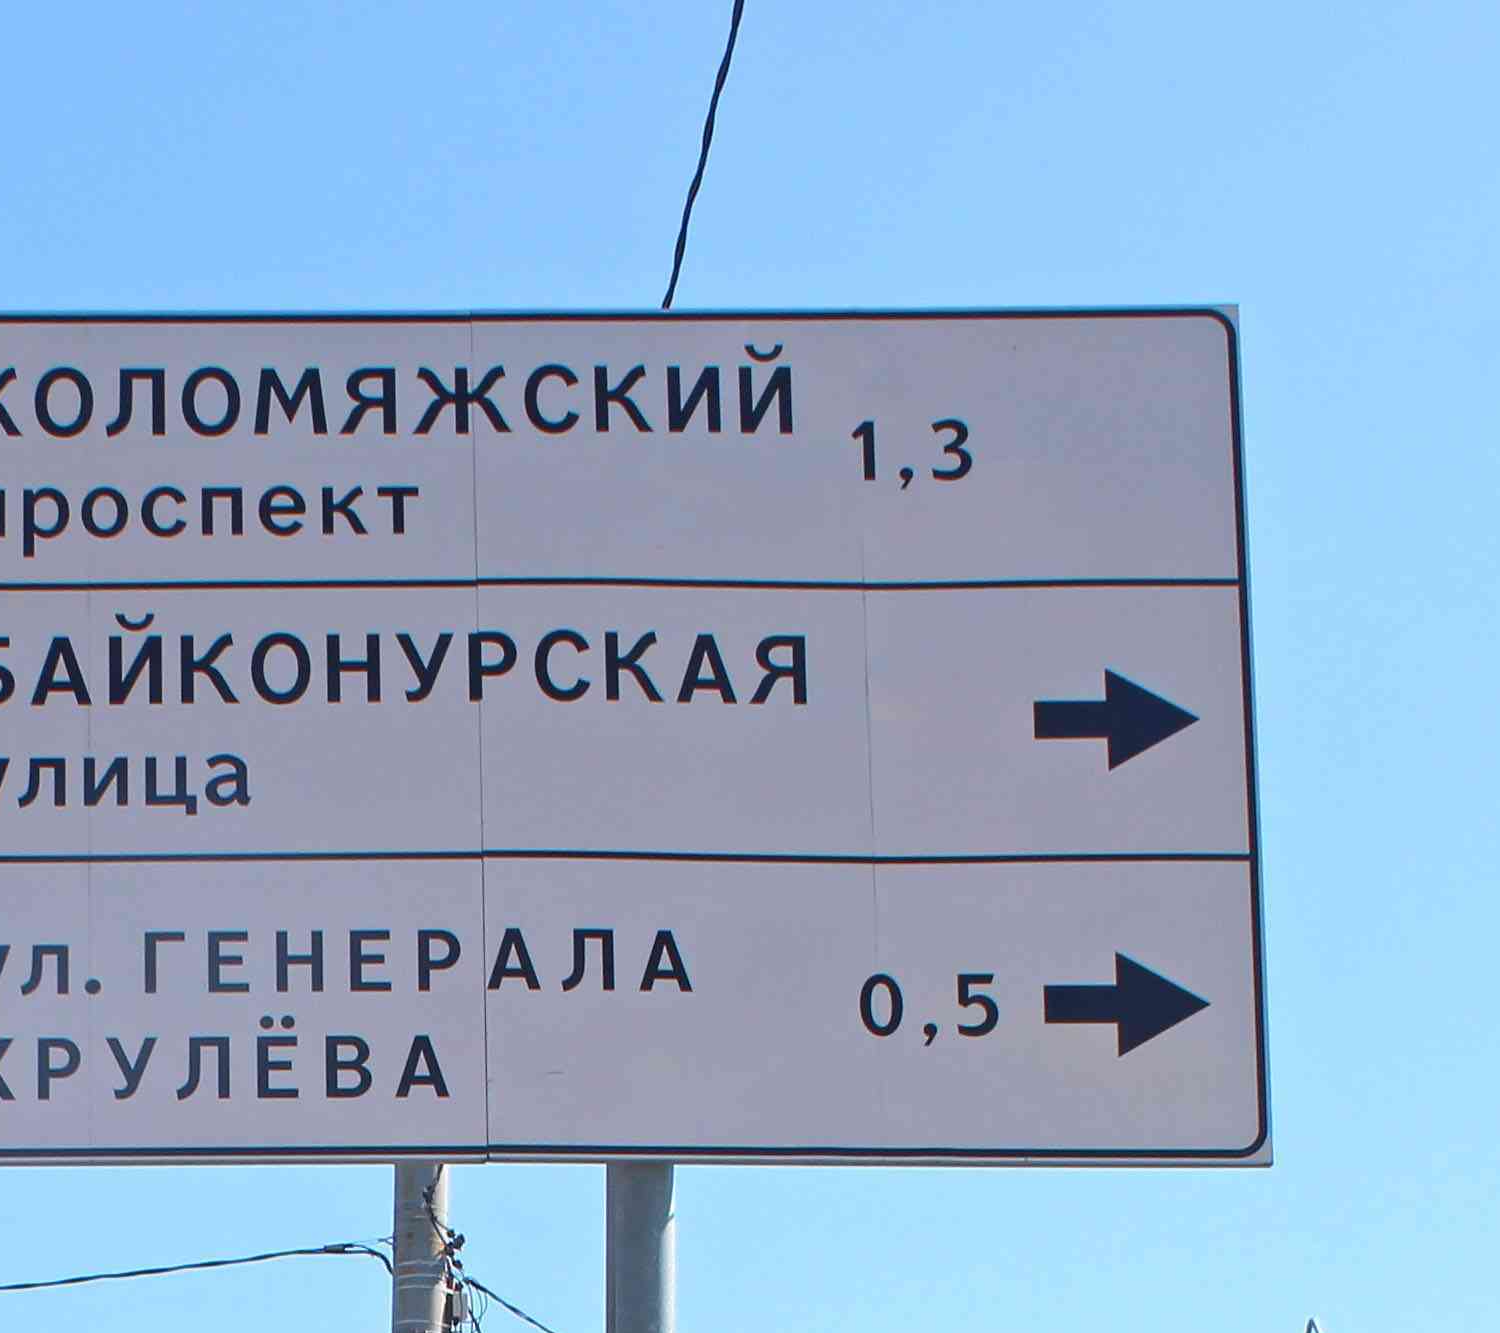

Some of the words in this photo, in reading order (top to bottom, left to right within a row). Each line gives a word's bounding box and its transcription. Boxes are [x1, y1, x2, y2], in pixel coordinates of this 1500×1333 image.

[851, 417, 974, 488] 1,3
[143, 926, 694, 995] ГЕНЕРАЛА
[858, 972, 1000, 1047] 0,5
